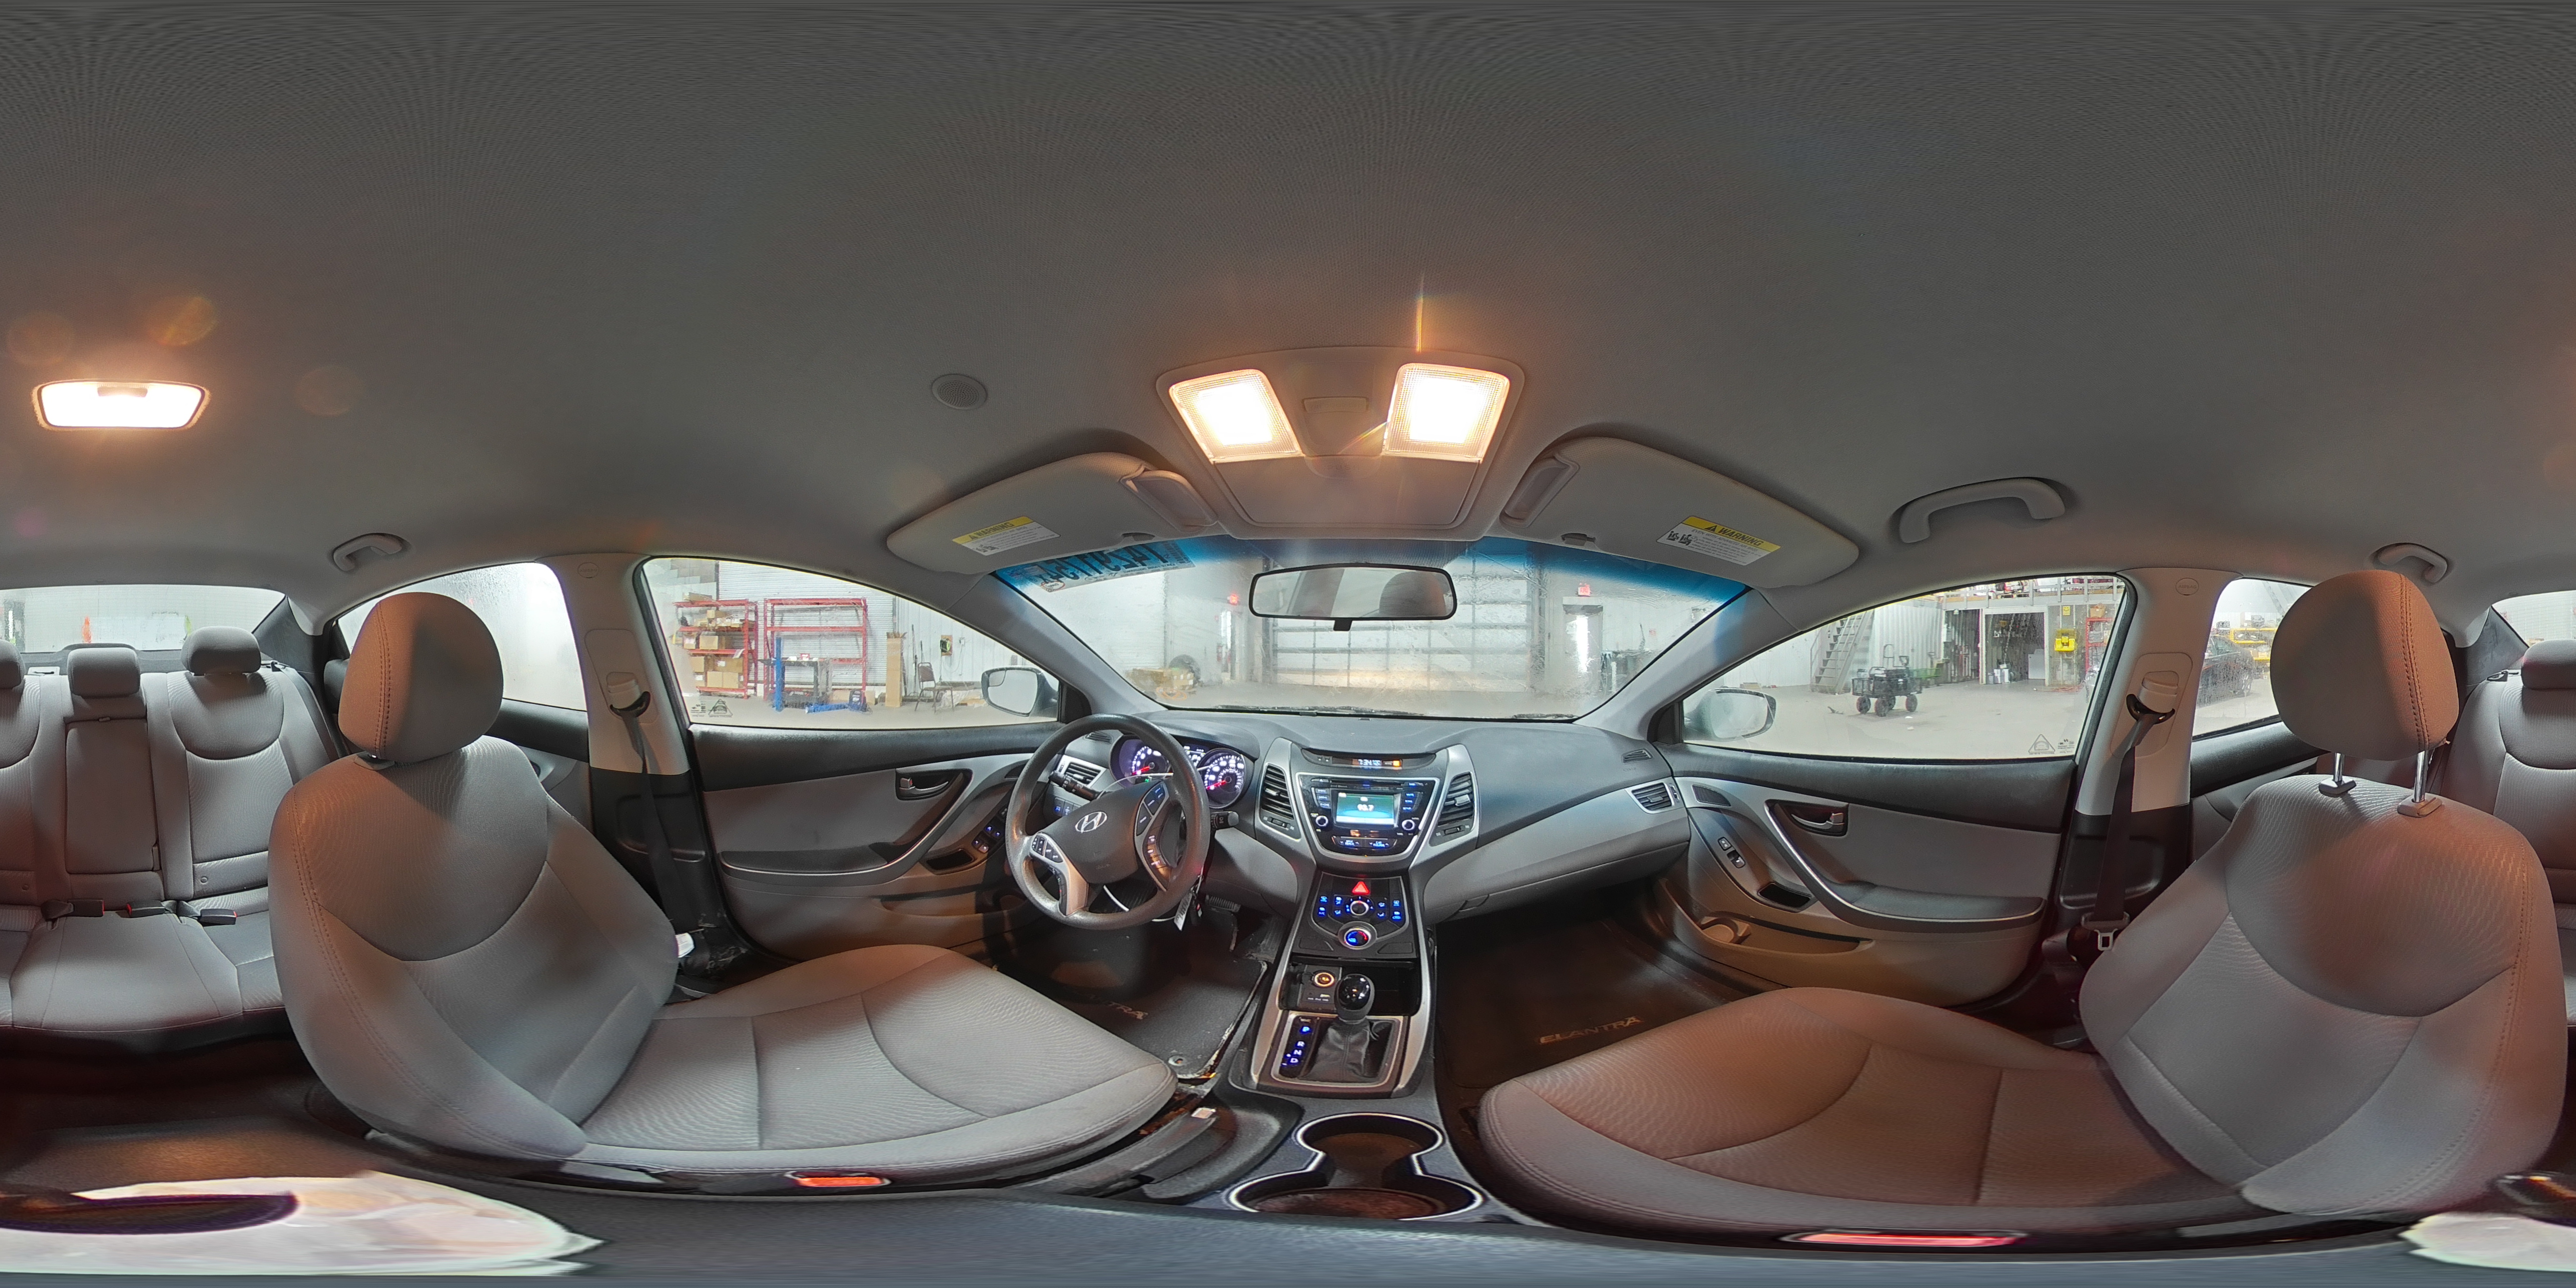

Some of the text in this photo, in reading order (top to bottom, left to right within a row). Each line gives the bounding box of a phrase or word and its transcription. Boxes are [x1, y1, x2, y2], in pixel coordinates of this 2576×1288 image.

[976, 522, 1015, 537] WARNING
[1718, 528, 1764, 546] WARNING
[1539, 1015, 1643, 1044] ELANTRA
